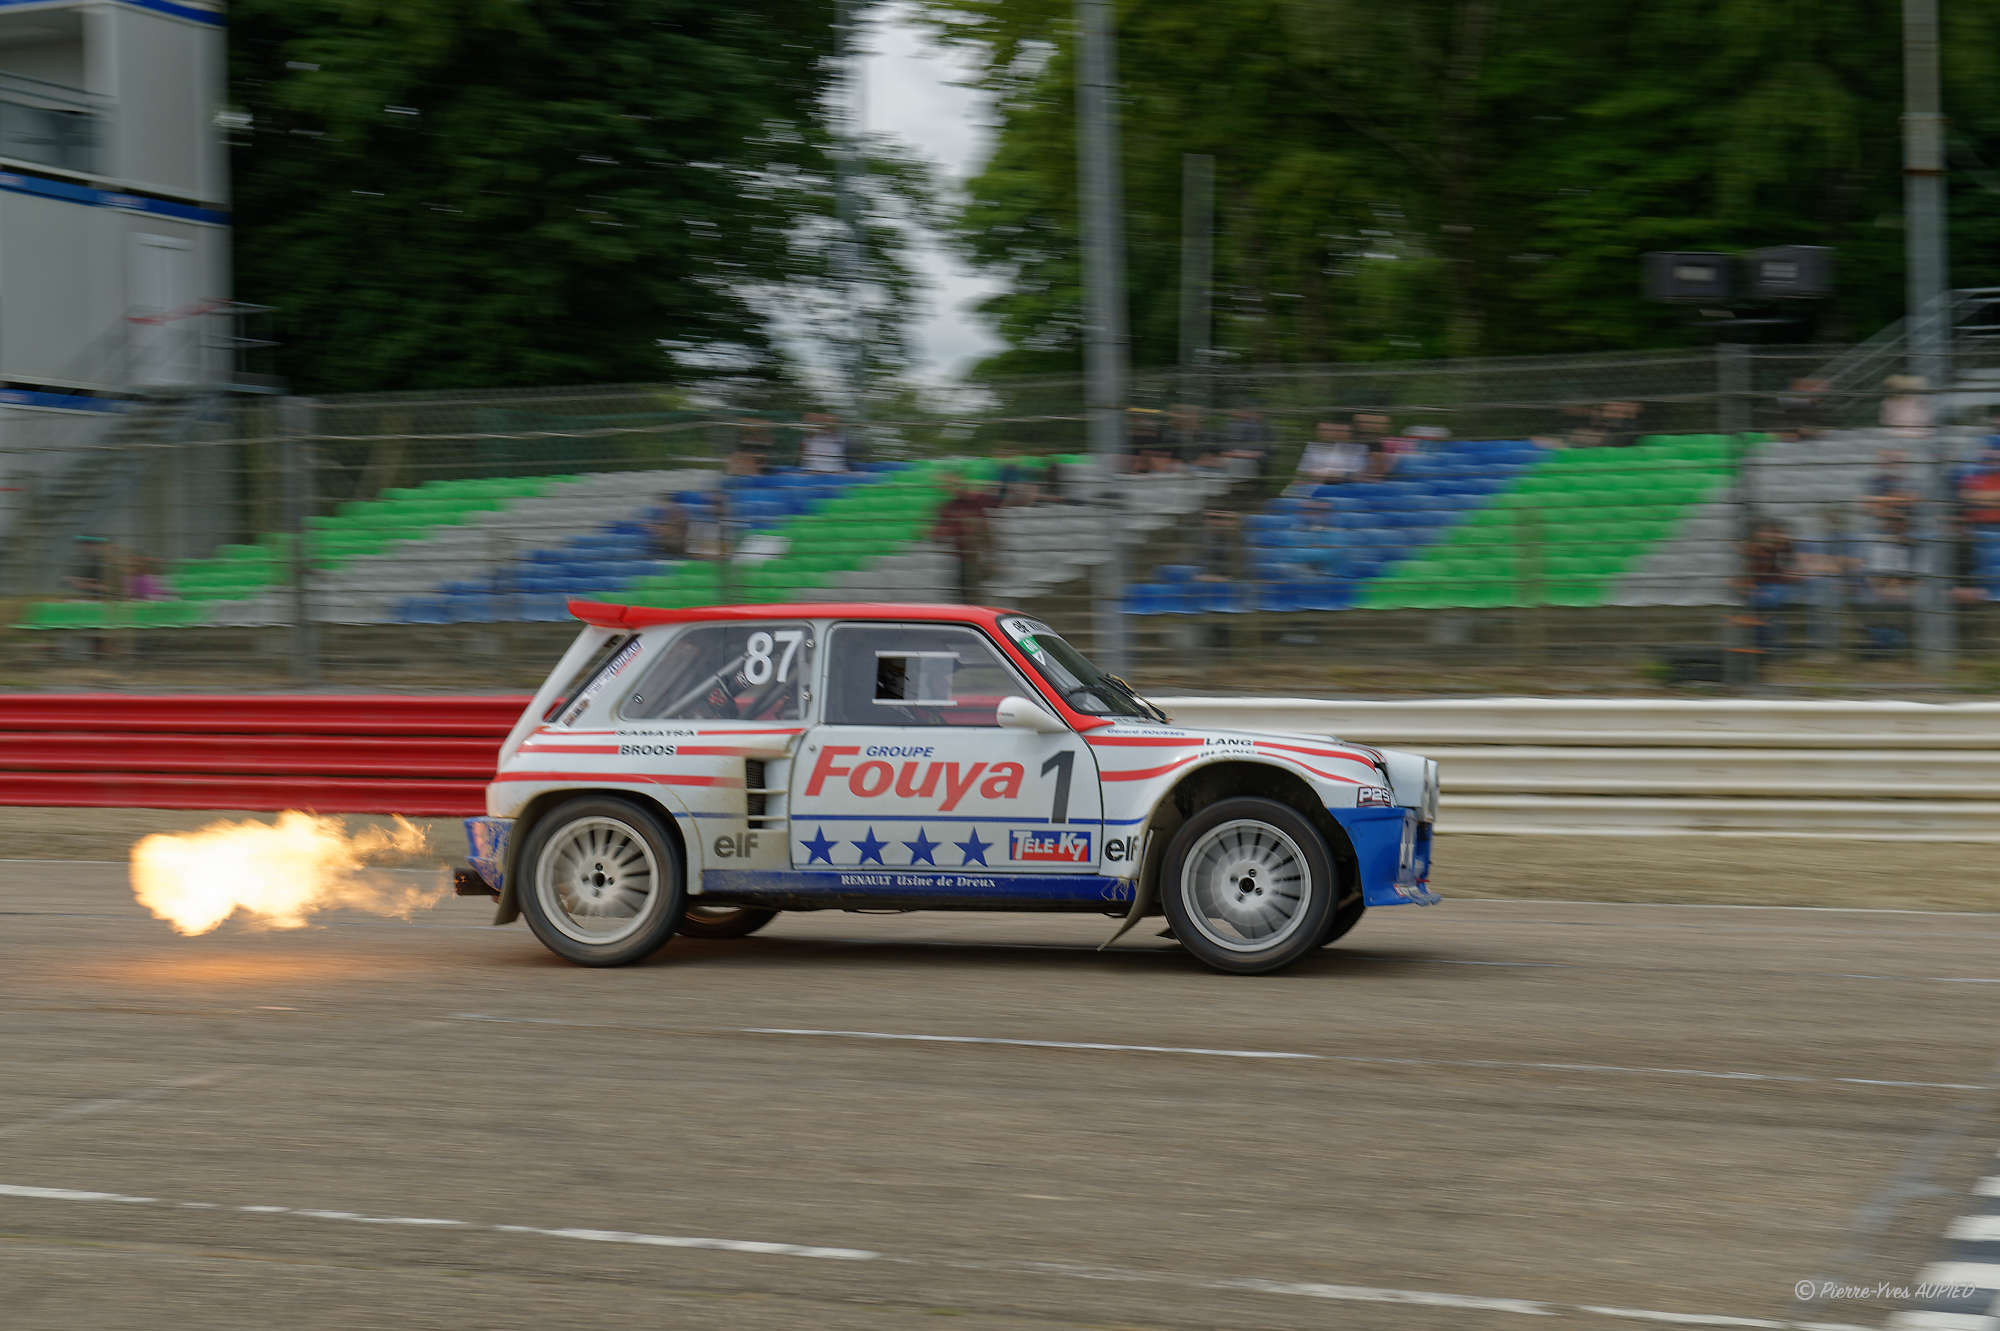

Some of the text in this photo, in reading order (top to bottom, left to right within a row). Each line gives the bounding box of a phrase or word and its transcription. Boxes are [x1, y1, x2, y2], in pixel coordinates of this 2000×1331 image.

[744, 630, 803, 685] 87
[621, 744, 676, 756] BROOS
[866, 745, 934, 758] GROUPE
[804, 745, 1025, 812] Fouya
[1040, 750, 1076, 824] 1
[713, 832, 759, 859] elf
[1058, 831, 1089, 862] K7
[1104, 835, 1139, 862] elf
[841, 874, 996, 888] RENAULT Usine de Dreux
